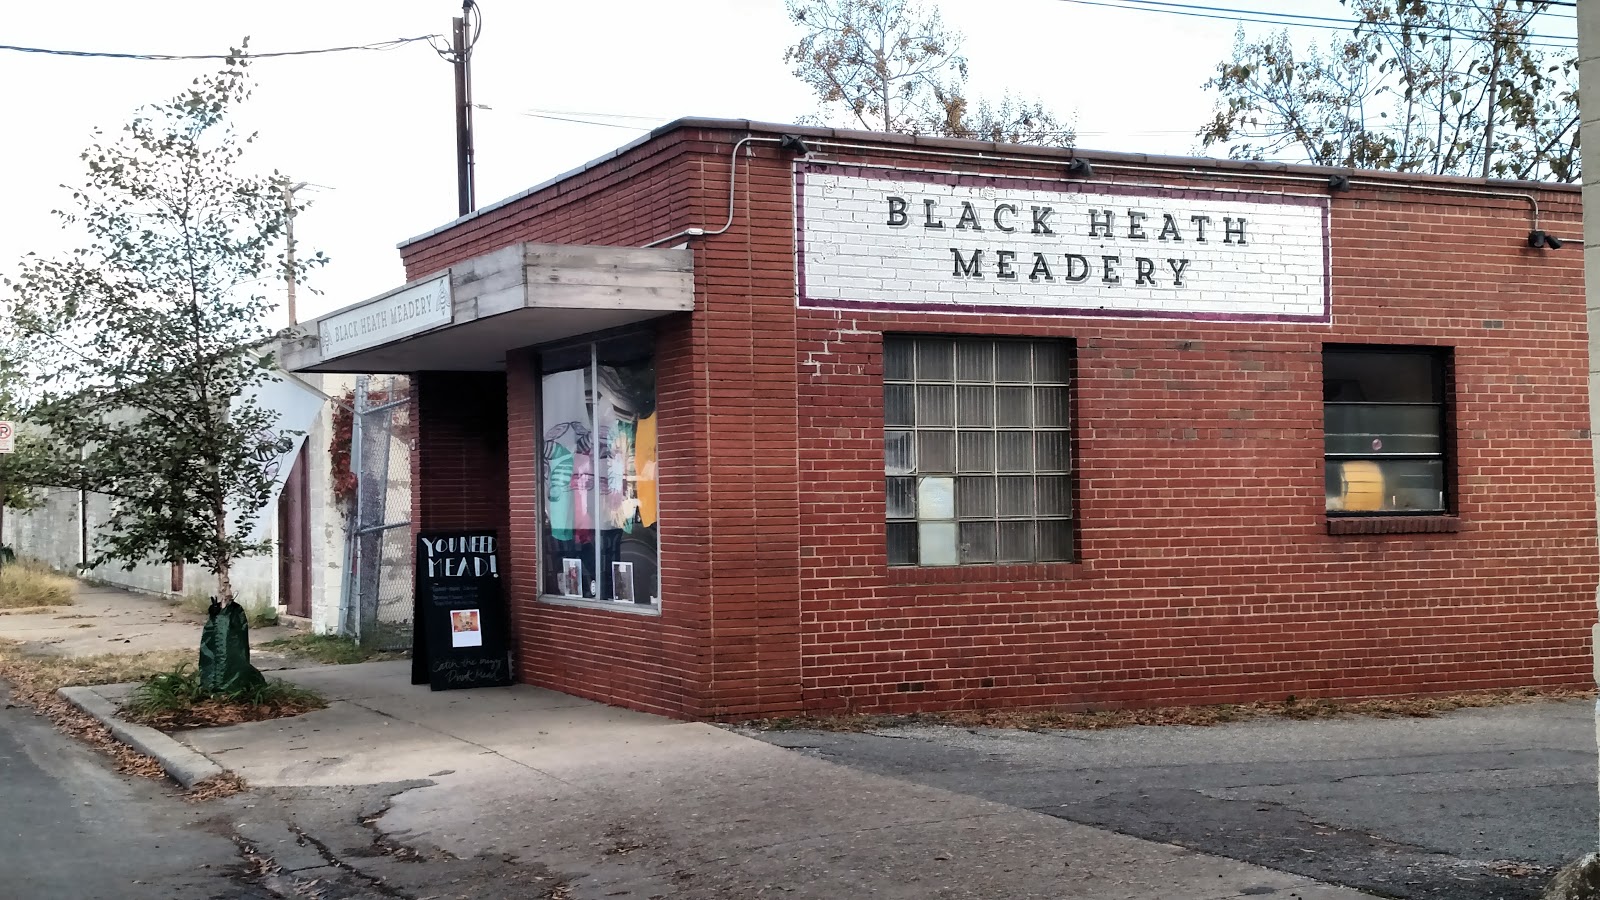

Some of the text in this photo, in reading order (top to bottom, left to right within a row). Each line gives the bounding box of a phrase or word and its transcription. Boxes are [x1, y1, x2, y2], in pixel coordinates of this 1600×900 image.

[886, 196, 1249, 245] BLACK HEATH
[950, 248, 1189, 287] MEADERY
[335, 293, 432, 343] BLACK HEATH MEADERY
[421, 535, 498, 557] YOU NEED
[428, 554, 499, 578] MEAD!
